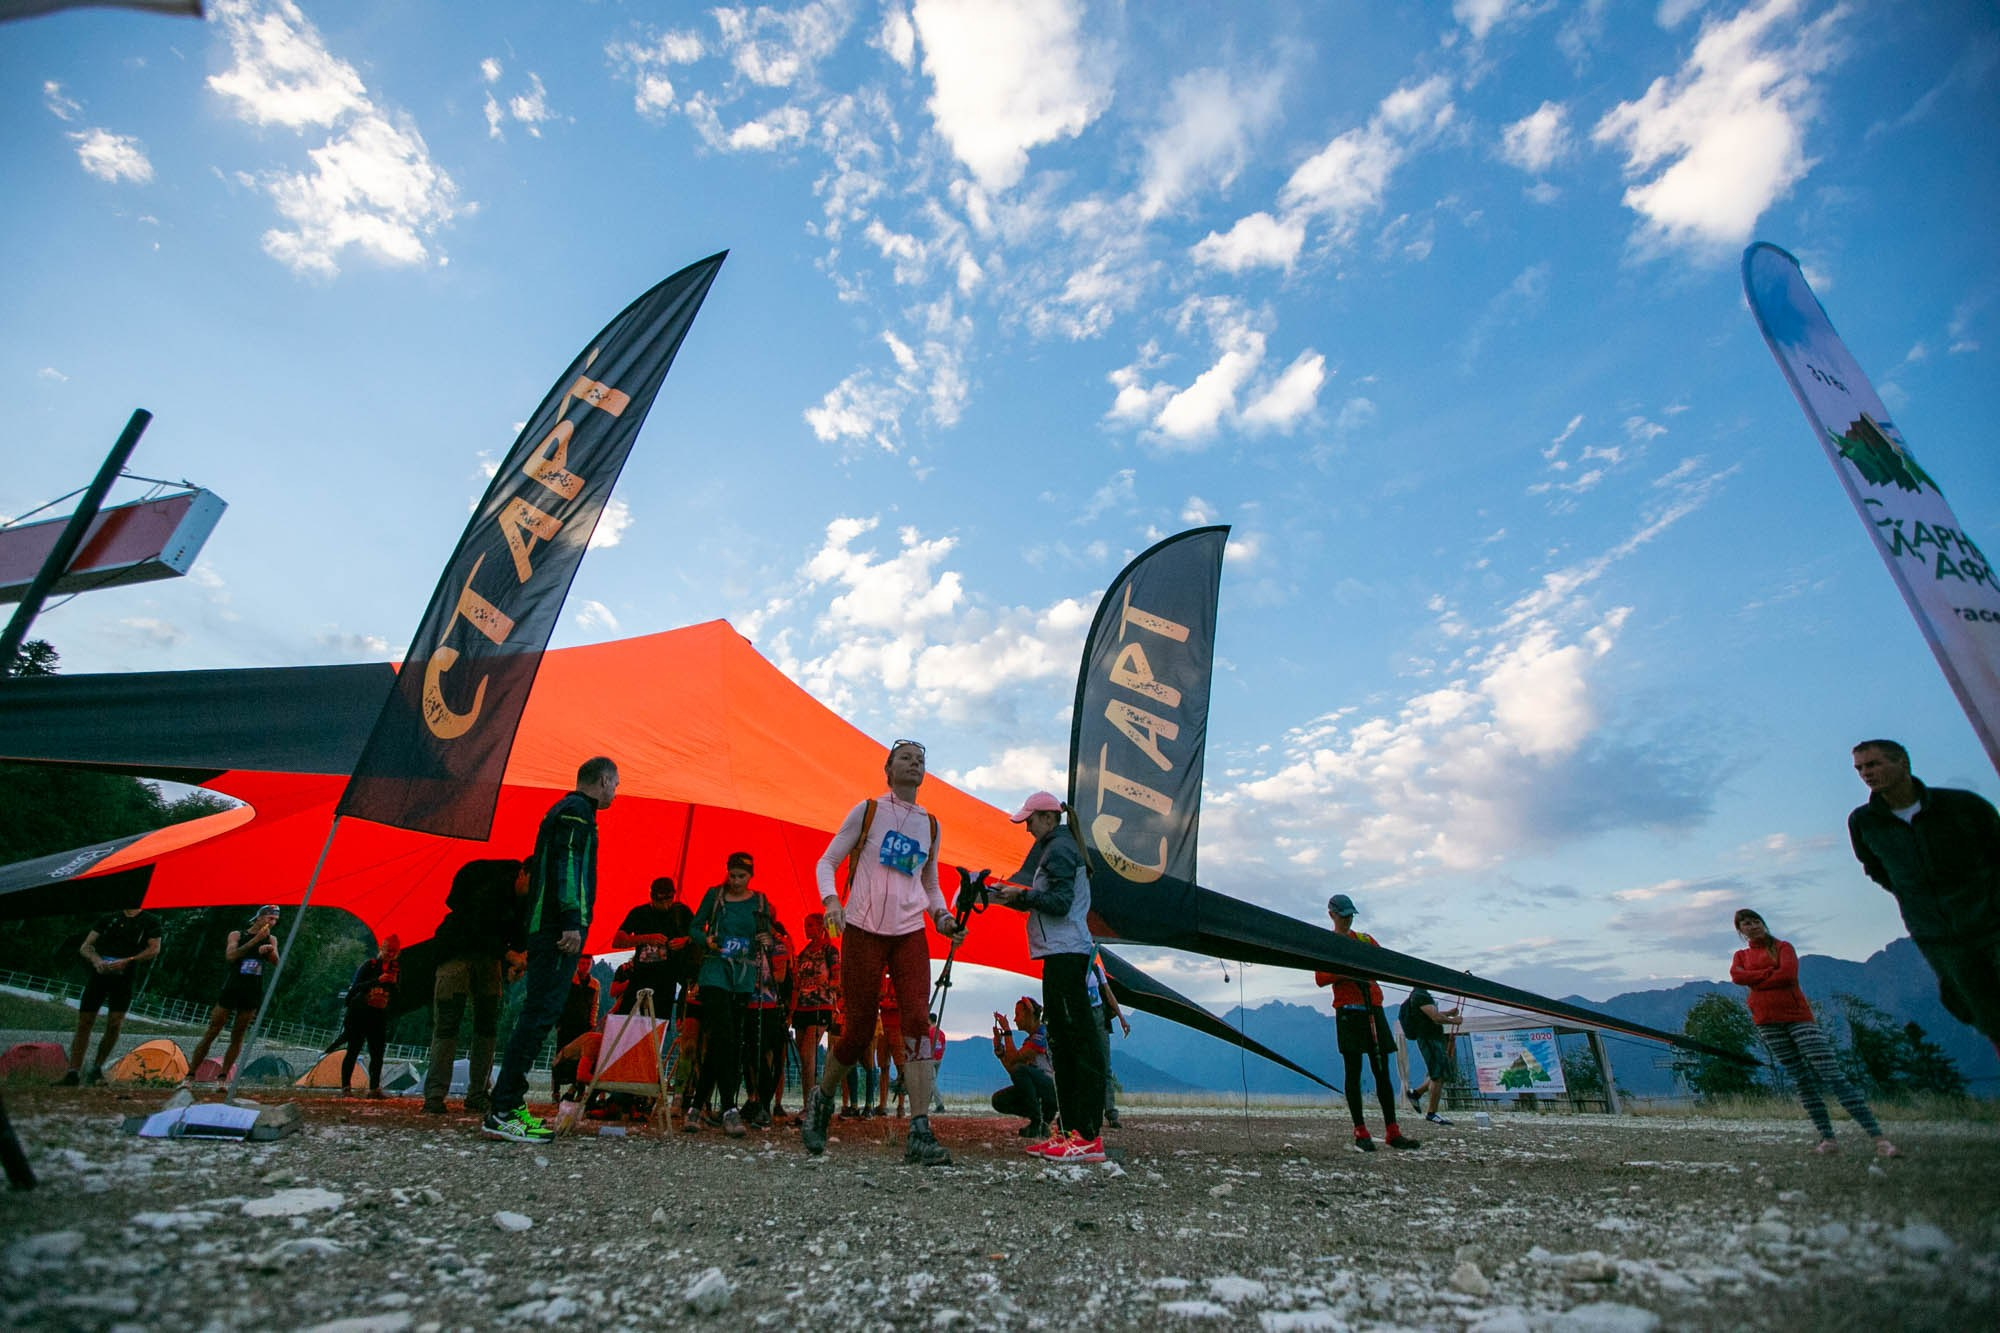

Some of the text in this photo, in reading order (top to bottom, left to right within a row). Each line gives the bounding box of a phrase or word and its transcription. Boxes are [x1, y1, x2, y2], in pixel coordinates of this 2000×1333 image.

[422, 346, 631, 740] СТАРТ
[1091, 582, 1190, 883] СТАРТ
[886, 836, 911, 855] 169
[1530, 1032, 1552, 1041] 2020
